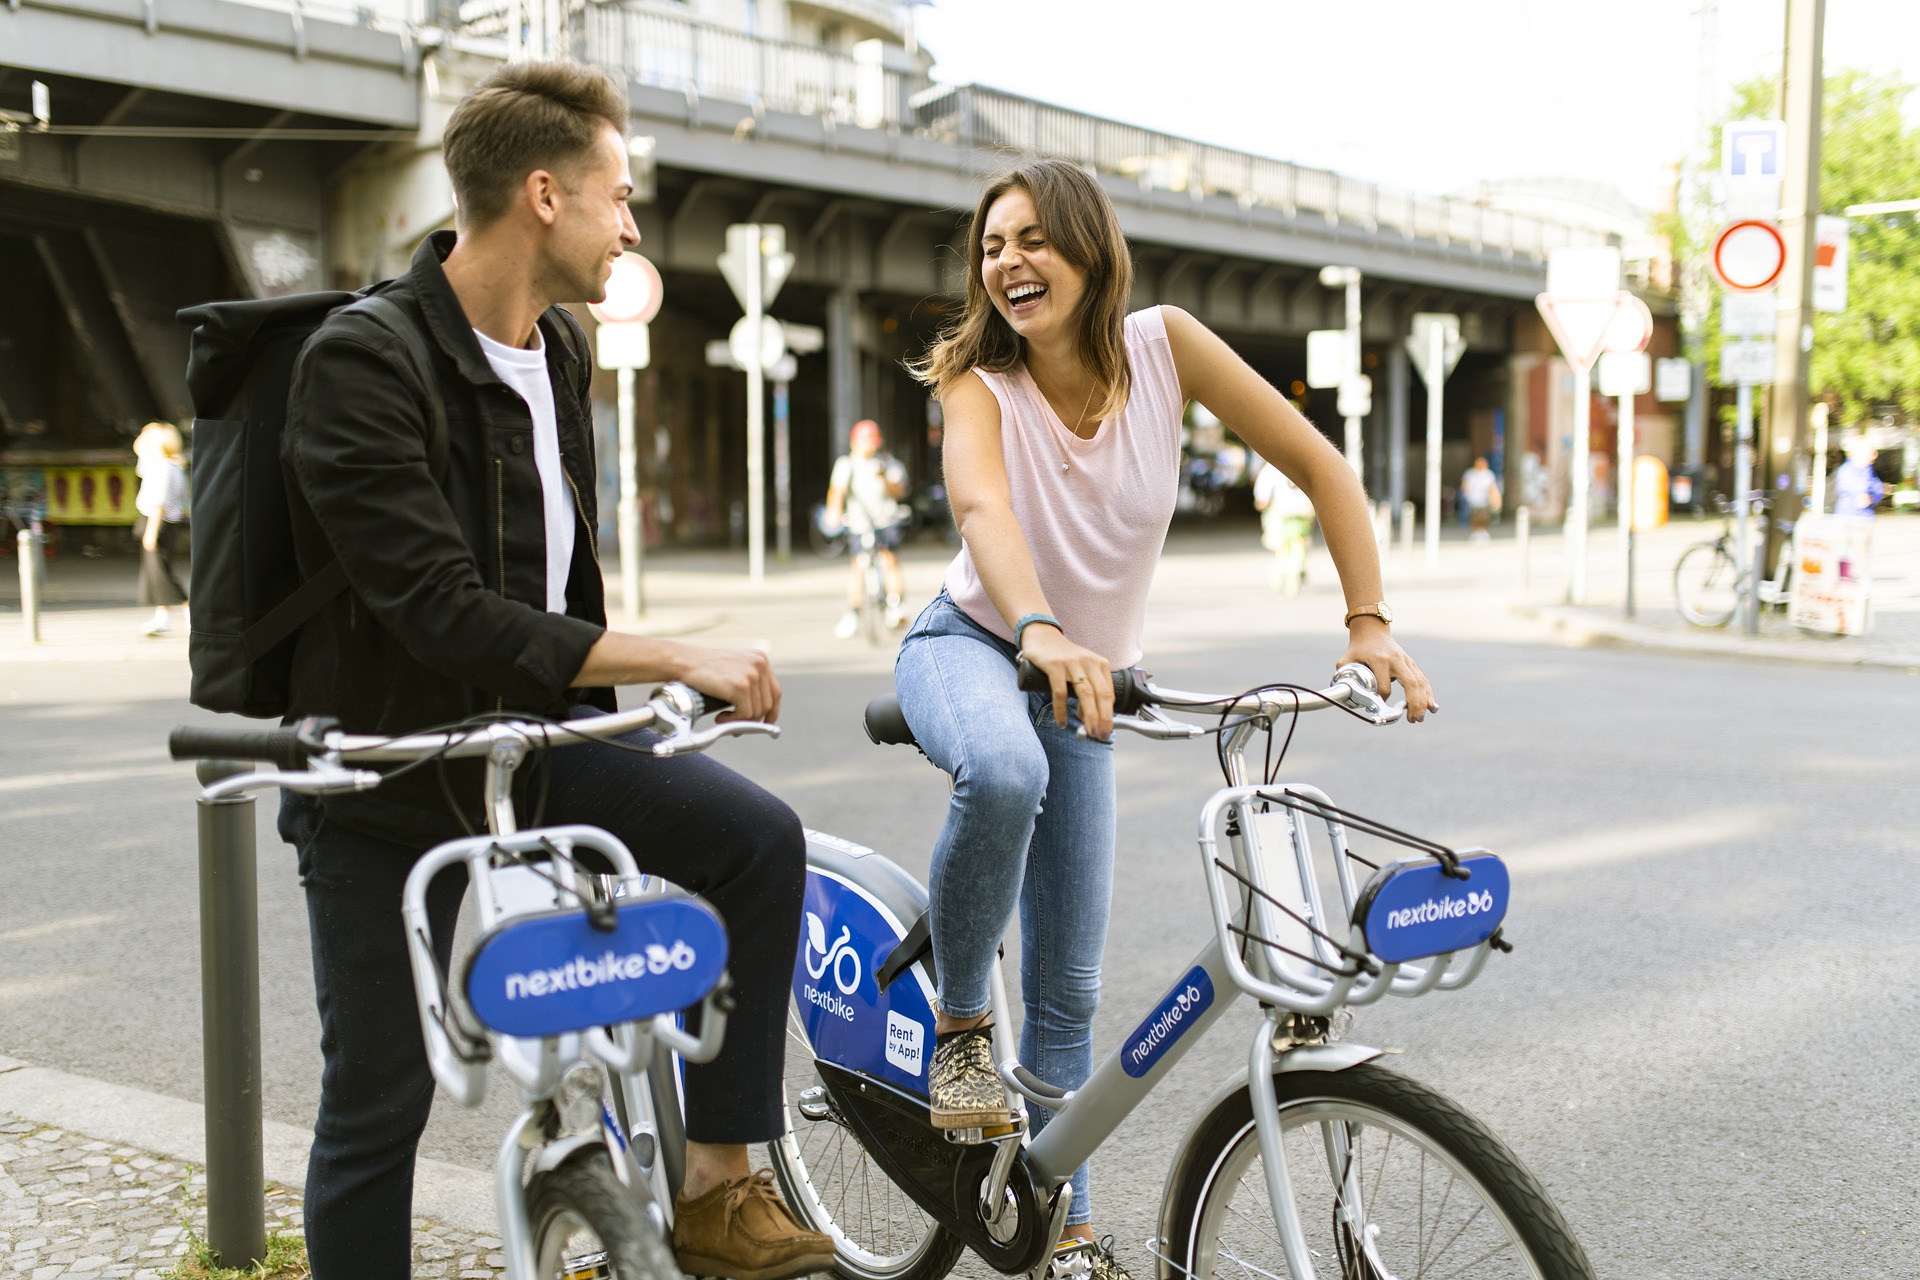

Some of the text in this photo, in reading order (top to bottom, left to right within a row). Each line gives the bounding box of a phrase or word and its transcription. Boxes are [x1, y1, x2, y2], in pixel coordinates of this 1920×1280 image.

[1387, 895, 1467, 930] nextbike
[505, 950, 647, 1000] nextbike
[804, 984, 855, 1022] nextbike
[890, 1023, 914, 1042] Rent
[1131, 1005, 1183, 1064] nextbike
[889, 1041, 920, 1061] by App!
